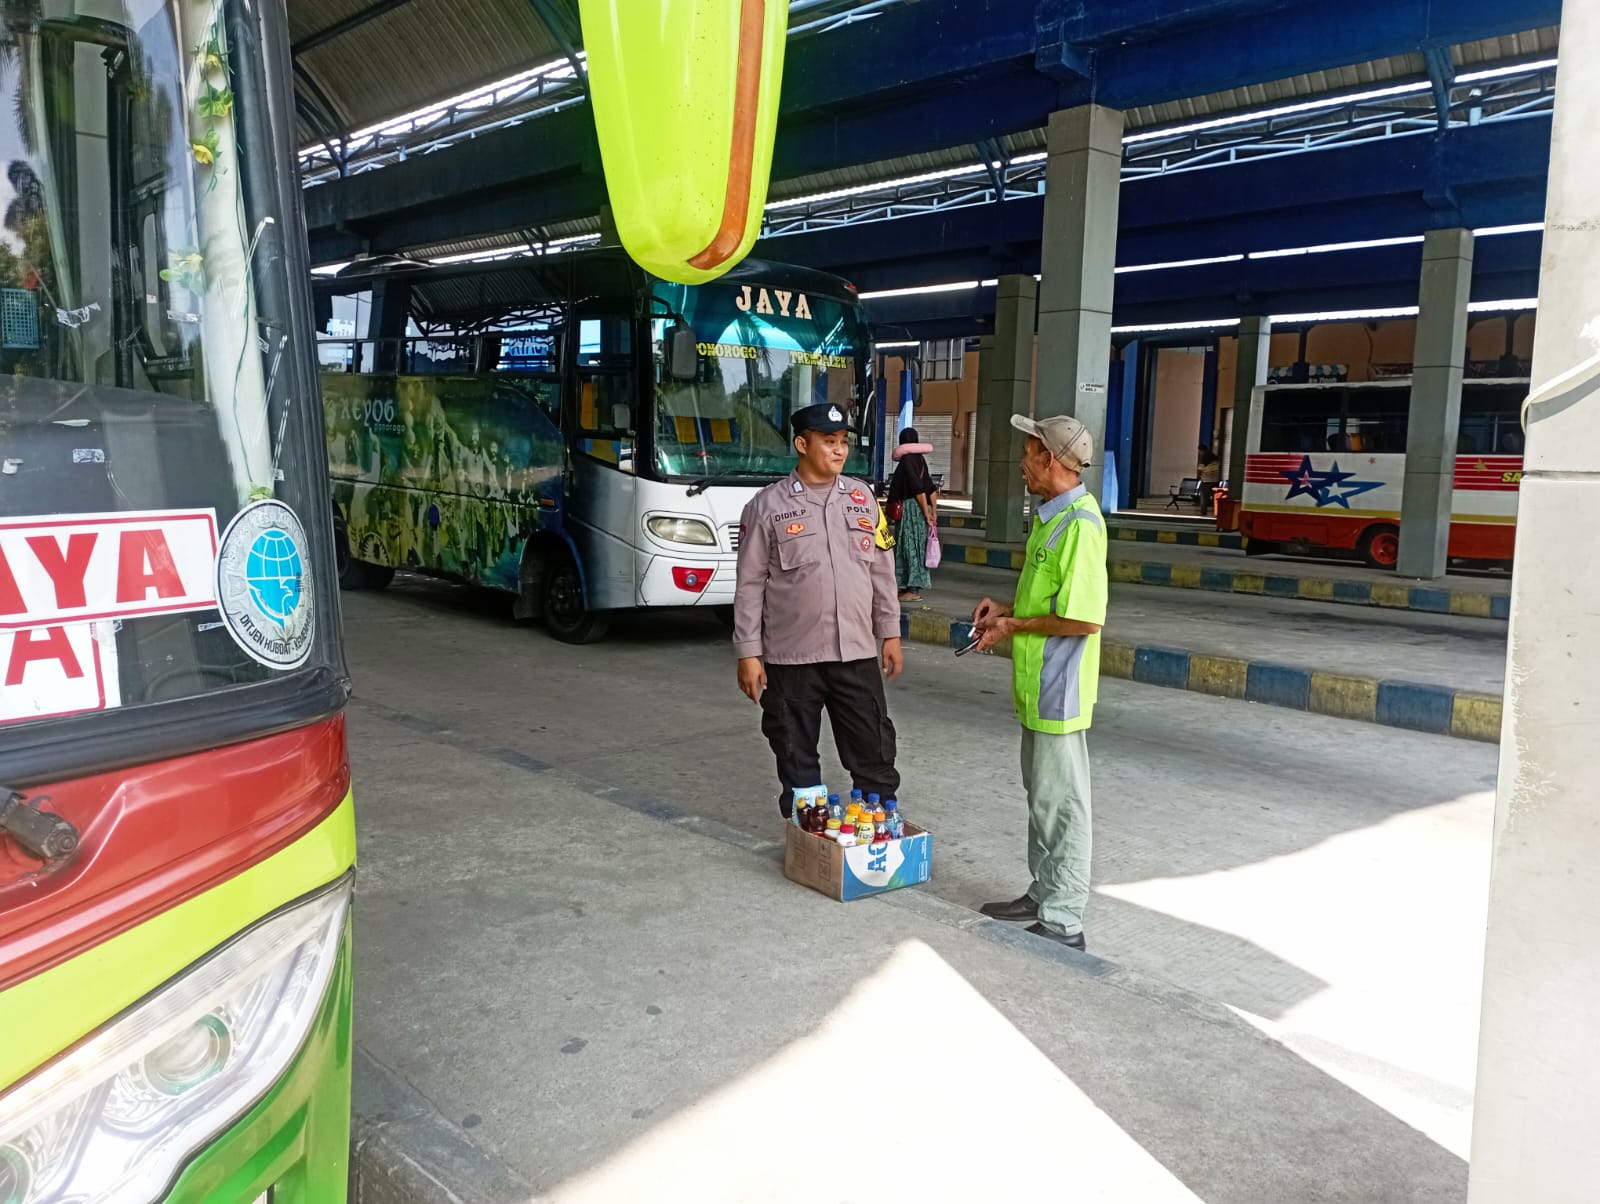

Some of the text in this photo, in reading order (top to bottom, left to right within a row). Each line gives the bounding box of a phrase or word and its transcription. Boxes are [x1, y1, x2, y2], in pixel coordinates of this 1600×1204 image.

[736, 285, 812, 320] JAYA
[696, 342, 757, 359] ONOROGO
[240, 614, 265, 645] DITJEN
[263, 637, 290, 655] HUBDAT
